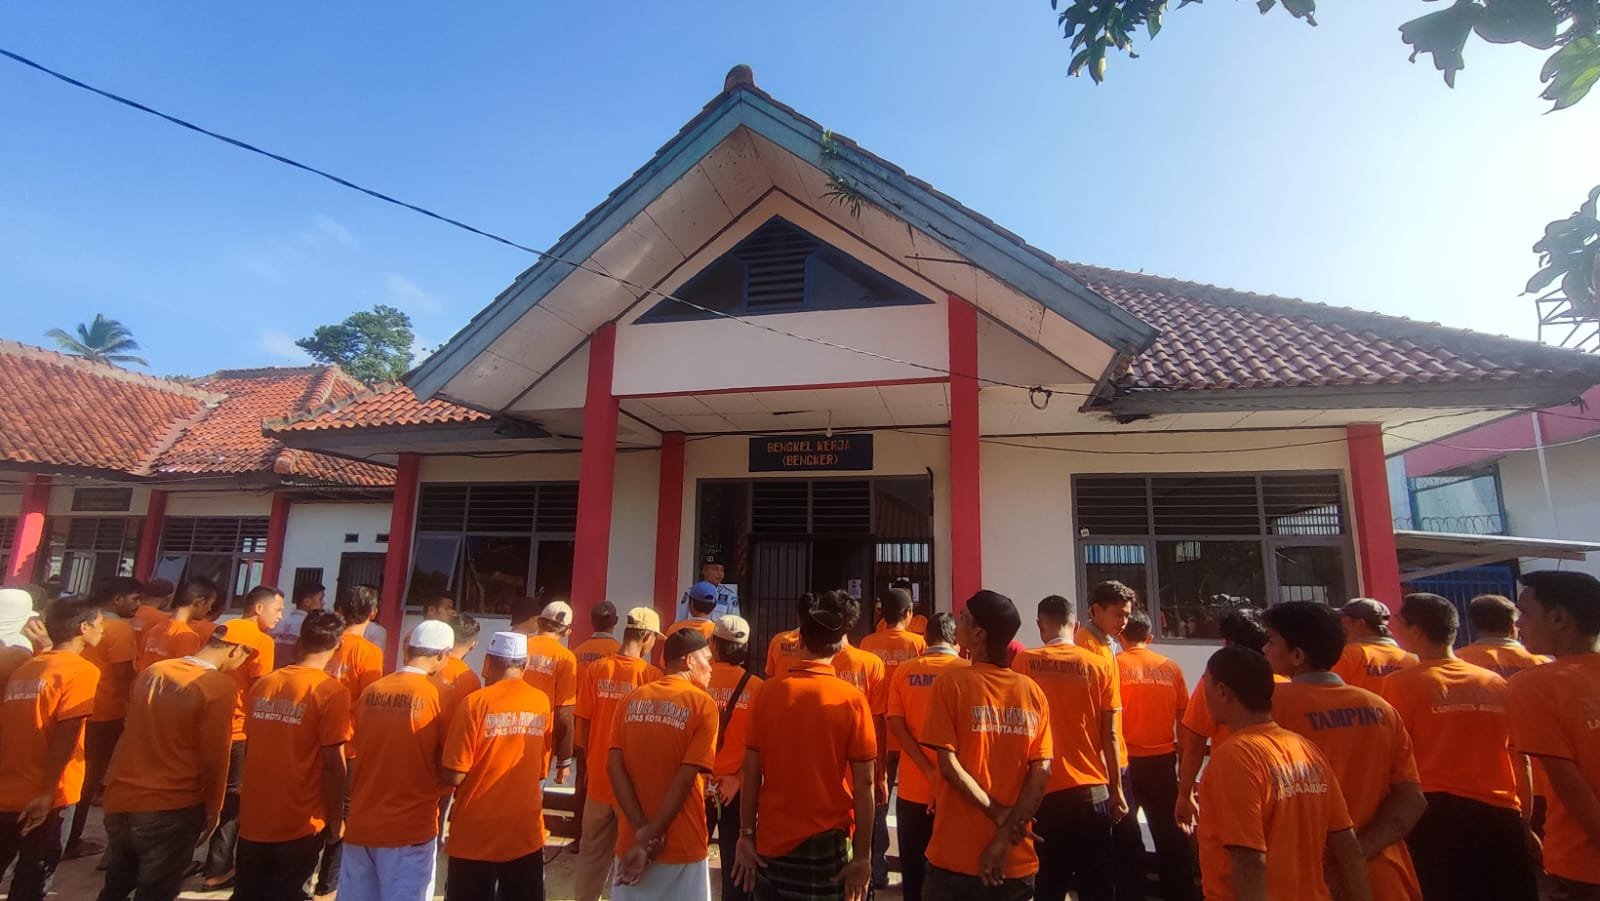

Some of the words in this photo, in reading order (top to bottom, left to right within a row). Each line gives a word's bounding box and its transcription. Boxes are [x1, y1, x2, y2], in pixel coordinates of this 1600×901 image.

[767, 440, 813, 453] BENGKEL
[816, 439, 850, 451] KERJA
[645, 714, 661, 723] KOTA
[662, 715, 686, 730] AGUNG
